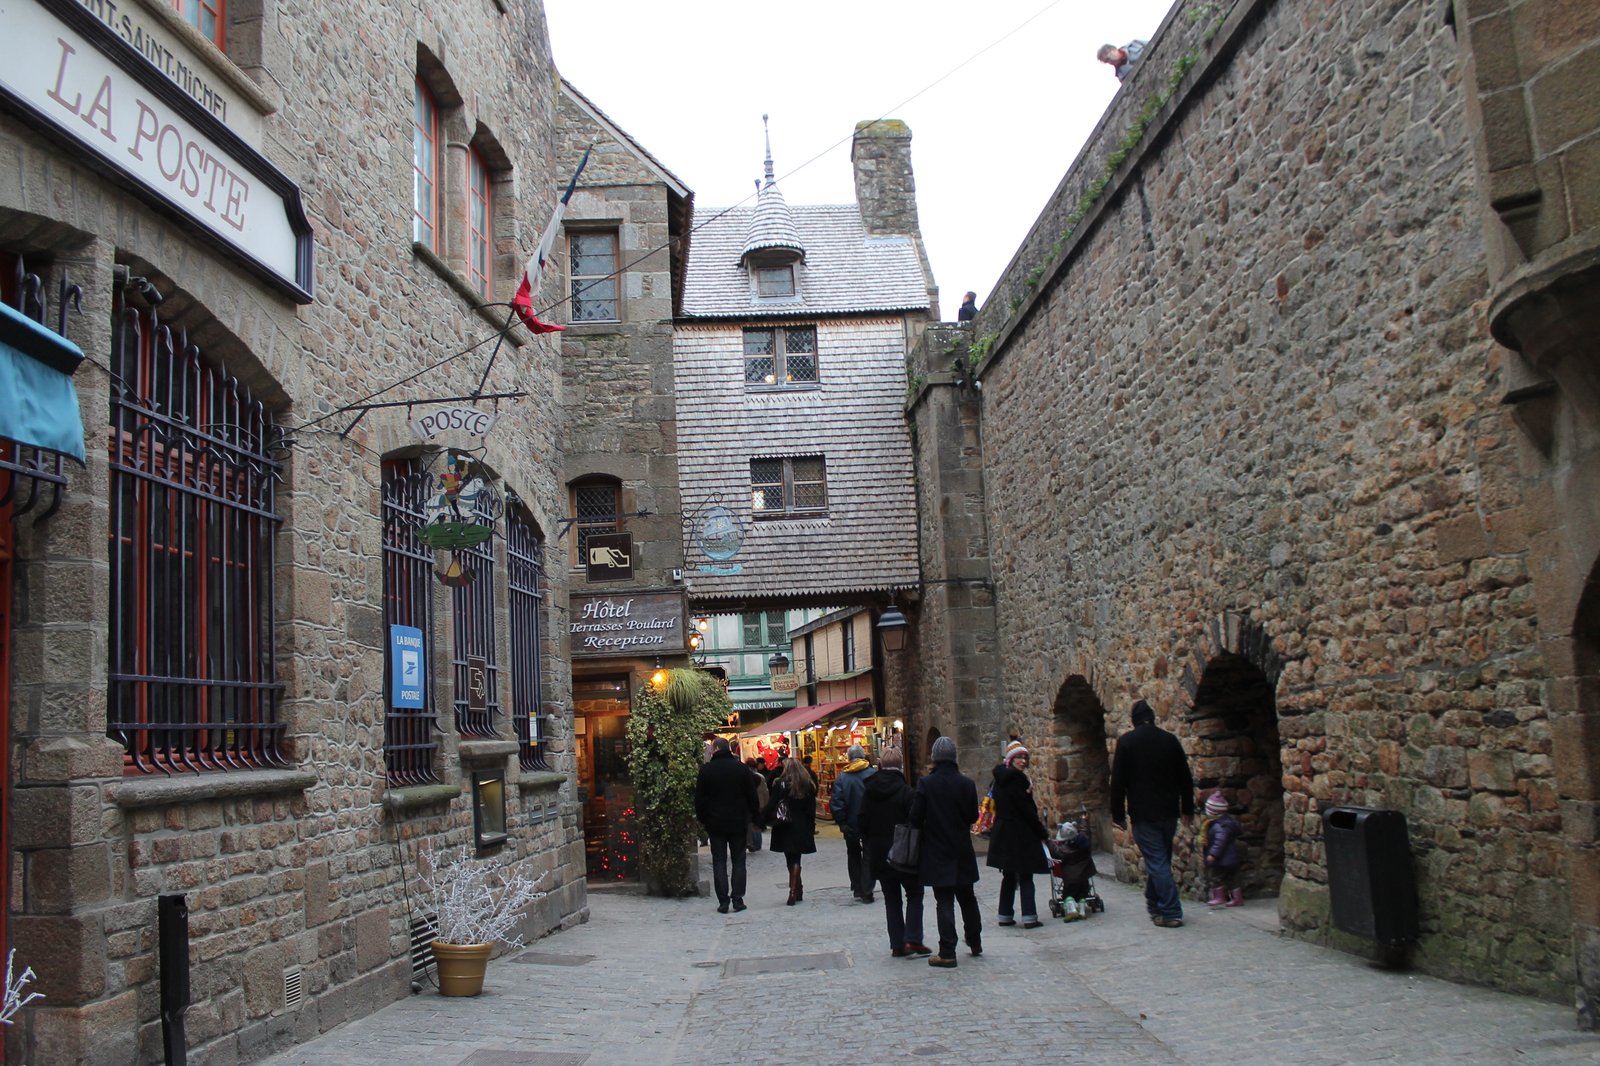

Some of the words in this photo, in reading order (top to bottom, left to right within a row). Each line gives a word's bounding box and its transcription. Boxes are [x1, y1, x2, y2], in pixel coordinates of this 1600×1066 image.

[47, 37, 117, 143] LA
[127, 98, 249, 232] POSTE
[419, 408, 490, 437] POSTE
[582, 599, 635, 619] Hôtel
[569, 622, 624, 633] Terrasses
[626, 616, 677, 630] Poulard
[396, 635, 404, 645] LA
[404, 636, 421, 648] BANQUE
[583, 633, 665, 649] Réception
[733, 702, 757, 711] SAINT
[759, 701, 783, 710] JAMES
